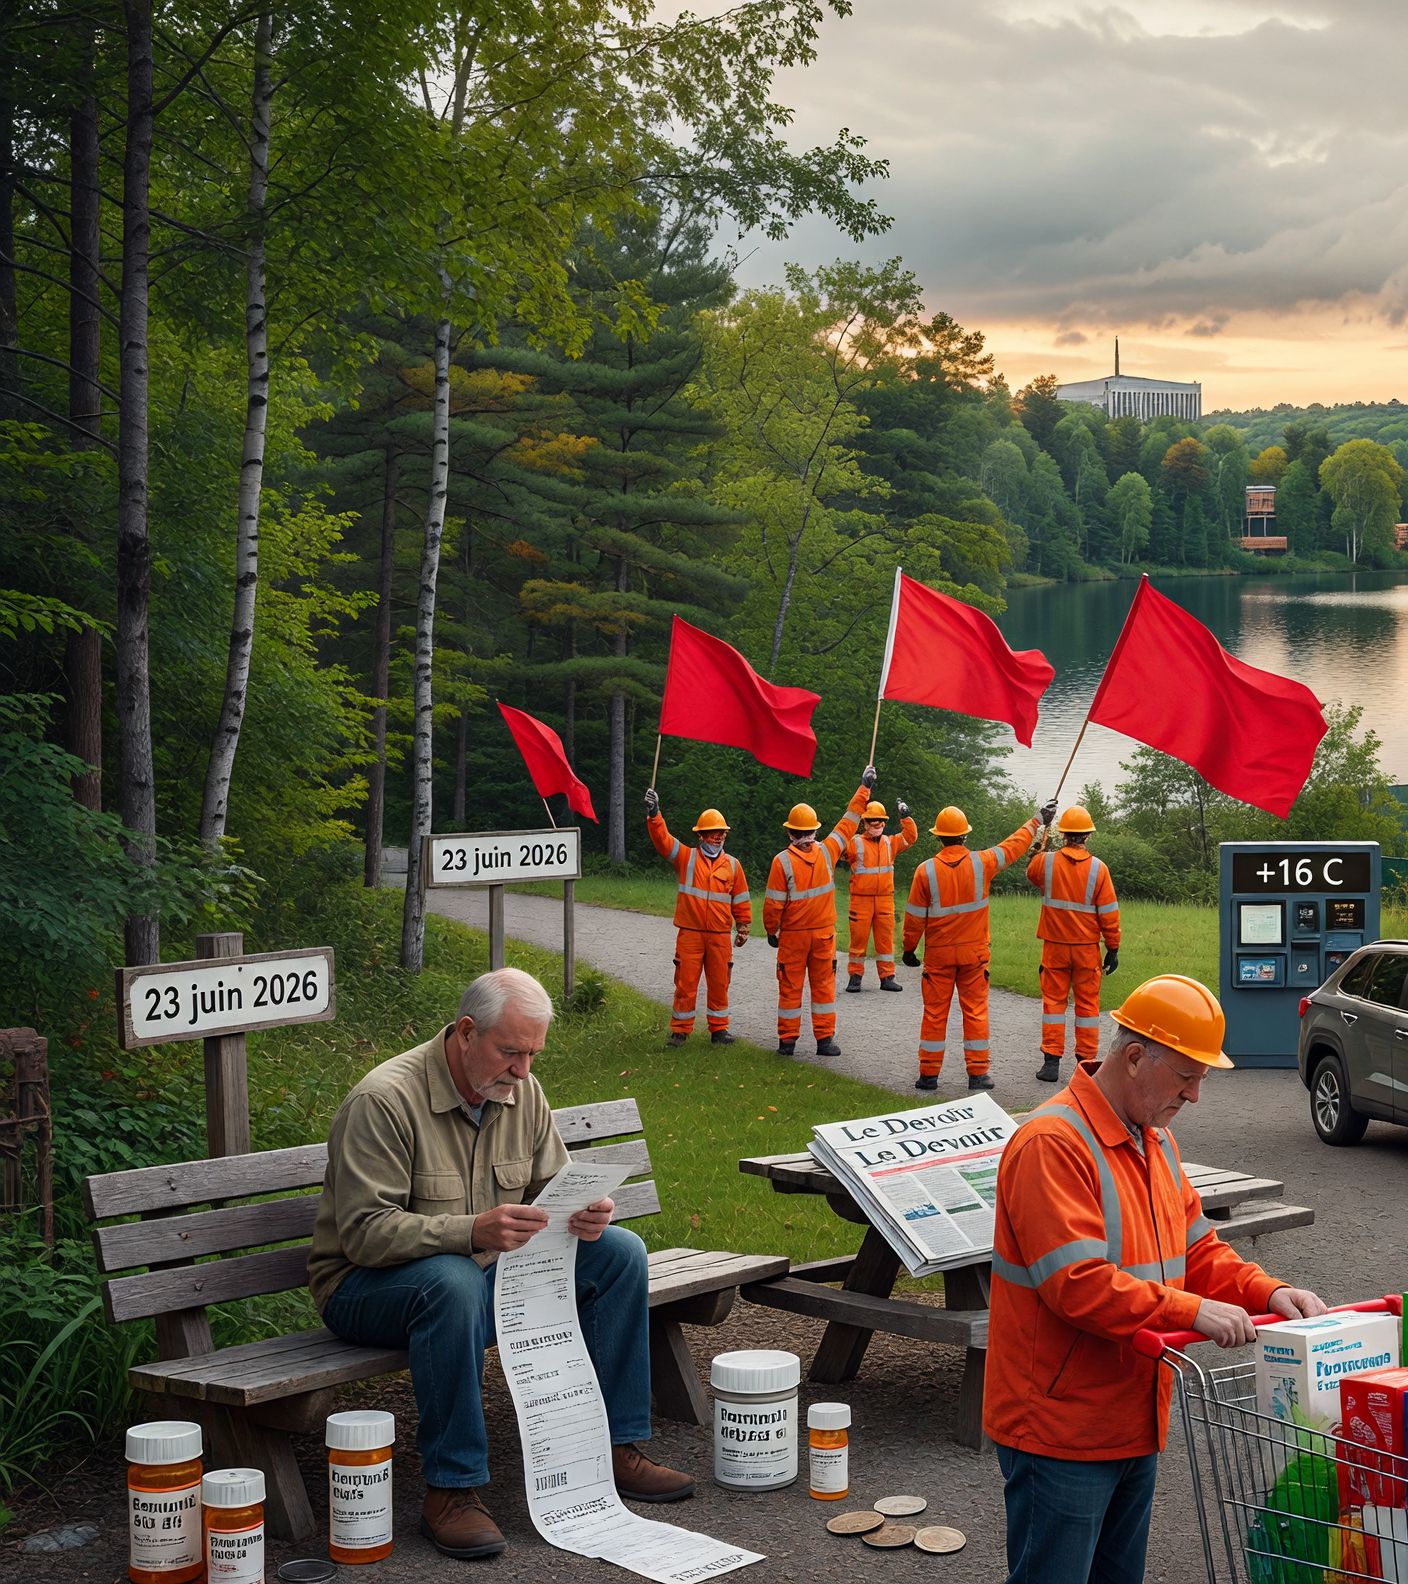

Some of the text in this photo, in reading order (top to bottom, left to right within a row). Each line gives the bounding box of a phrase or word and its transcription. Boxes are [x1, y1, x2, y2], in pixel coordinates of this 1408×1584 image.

[442, 843, 568, 875] 23 juin 2026
[1256, 858, 1344, 886] +16 C
[145, 970, 318, 1025] 23 juin 2026
[841, 1126, 880, 1142] Le
[854, 1150, 897, 1168] Le
